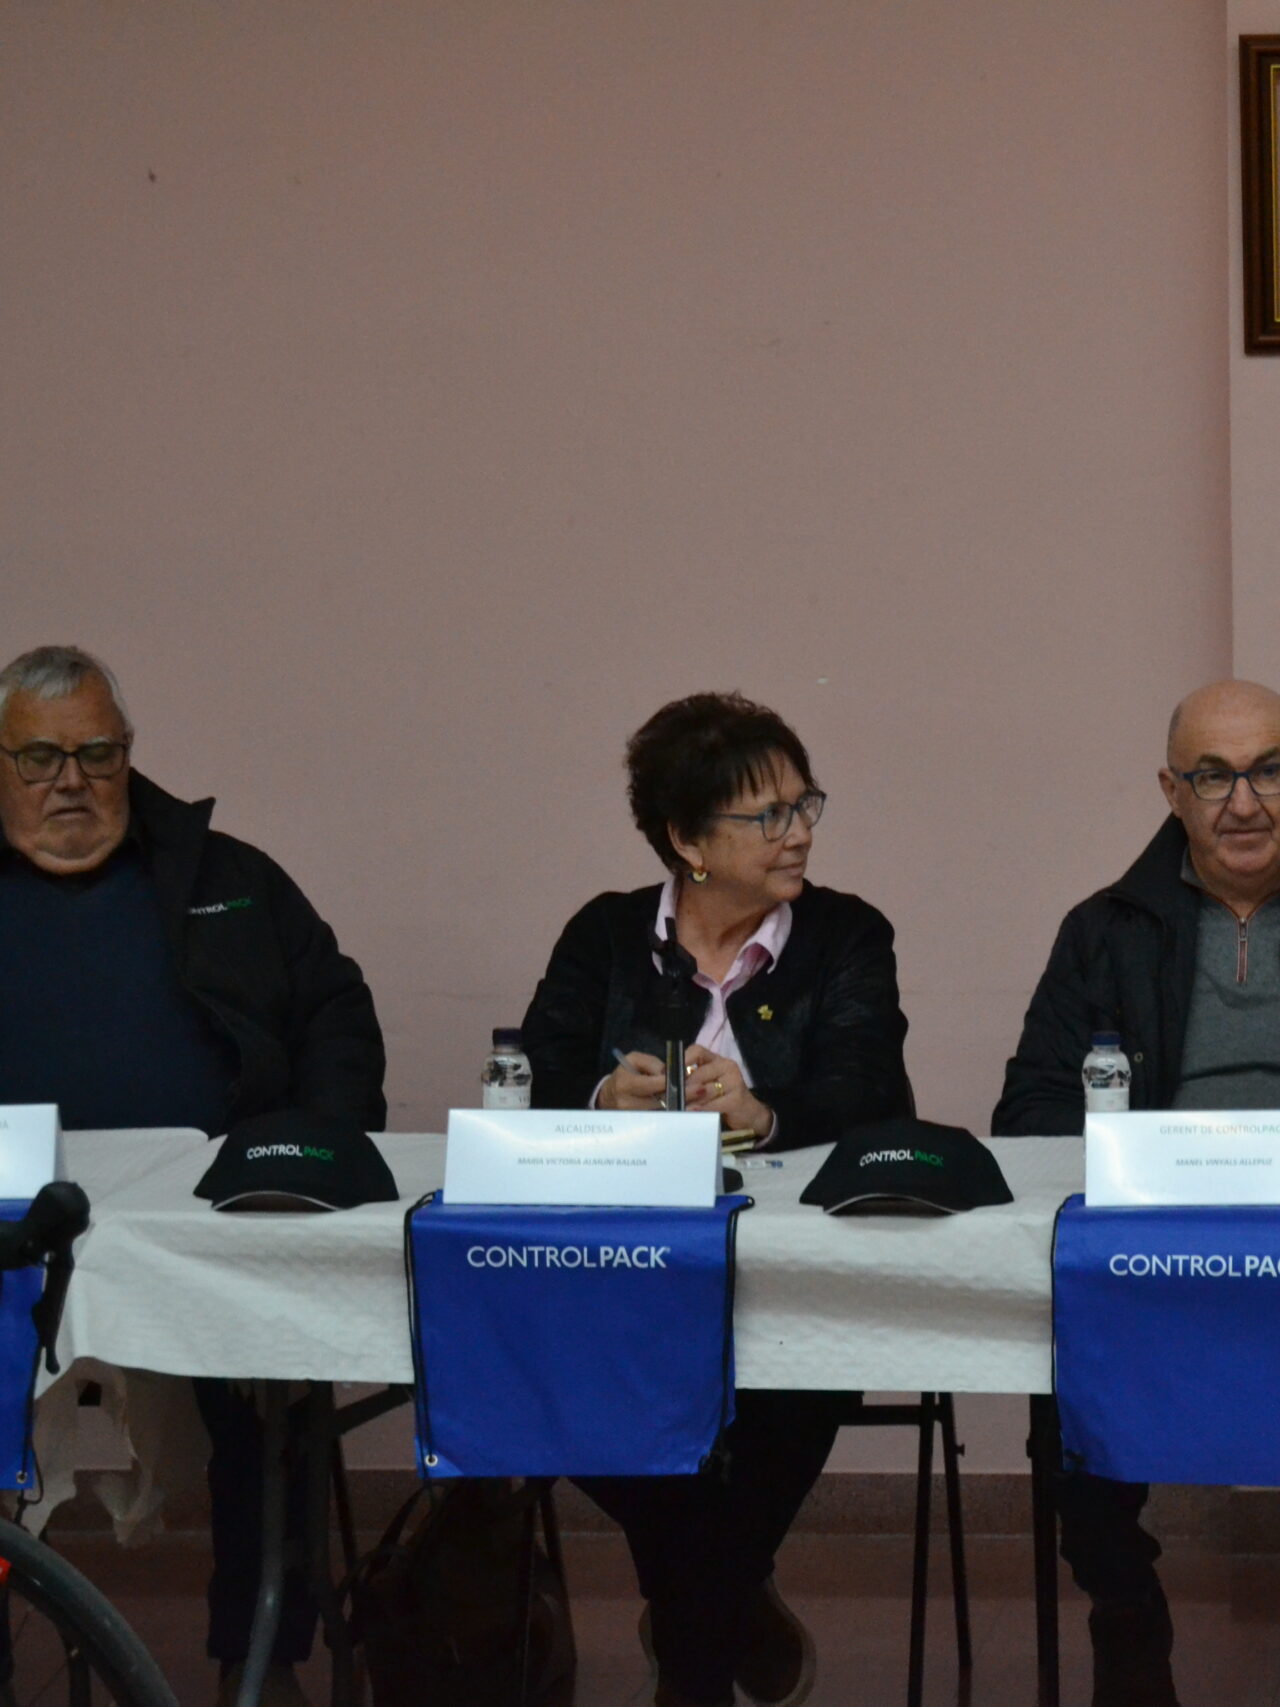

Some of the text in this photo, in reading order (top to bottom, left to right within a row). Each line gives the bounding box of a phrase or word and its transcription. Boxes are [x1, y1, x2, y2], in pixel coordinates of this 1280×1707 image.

[555, 1124, 614, 1134] ALCALDESSA
[1159, 1125, 1197, 1135] GERENT
[1200, 1125, 1212, 1134] DE
[246, 1144, 335, 1160] CONTROLPACK
[859, 1149, 944, 1167] CONTROLPACK
